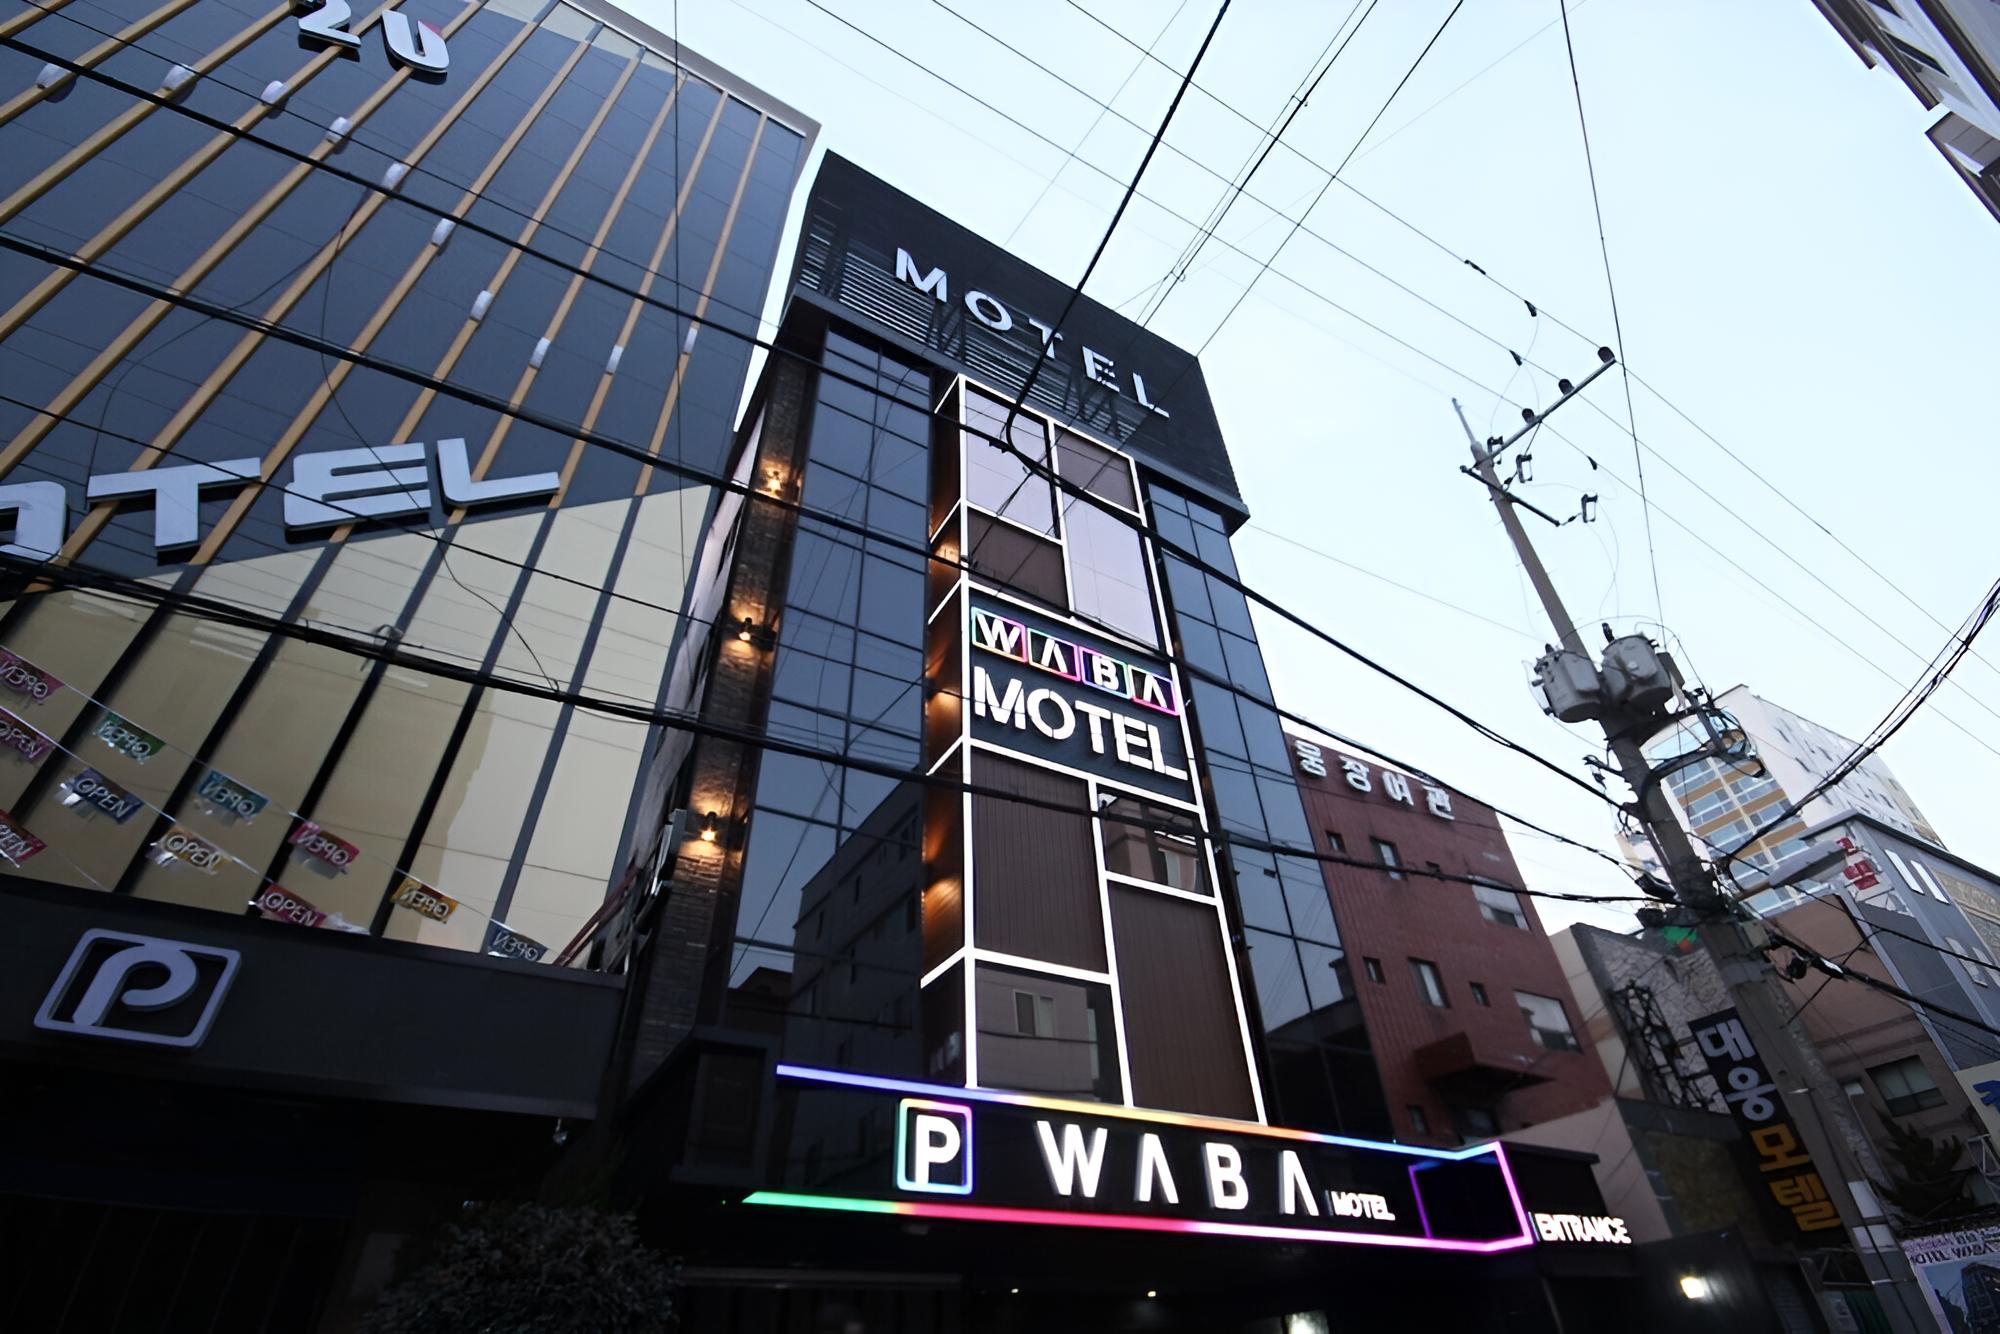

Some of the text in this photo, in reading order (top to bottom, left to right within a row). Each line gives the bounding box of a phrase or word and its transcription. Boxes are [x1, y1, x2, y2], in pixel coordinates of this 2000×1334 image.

[895, 247, 1170, 419] MOTEL
[976, 611, 1170, 710] WABA
[974, 666, 1188, 781] MOTEL
[76, 777, 135, 819] OPEN
[166, 834, 222, 873] OPEN
[266, 892, 319, 927] OPEN
[71, 943, 198, 1028] P
[914, 1115, 961, 1185] P
[1036, 1119, 1396, 1221] WABA MOTEL
[1534, 1213, 1632, 1244] ENTRANCE
